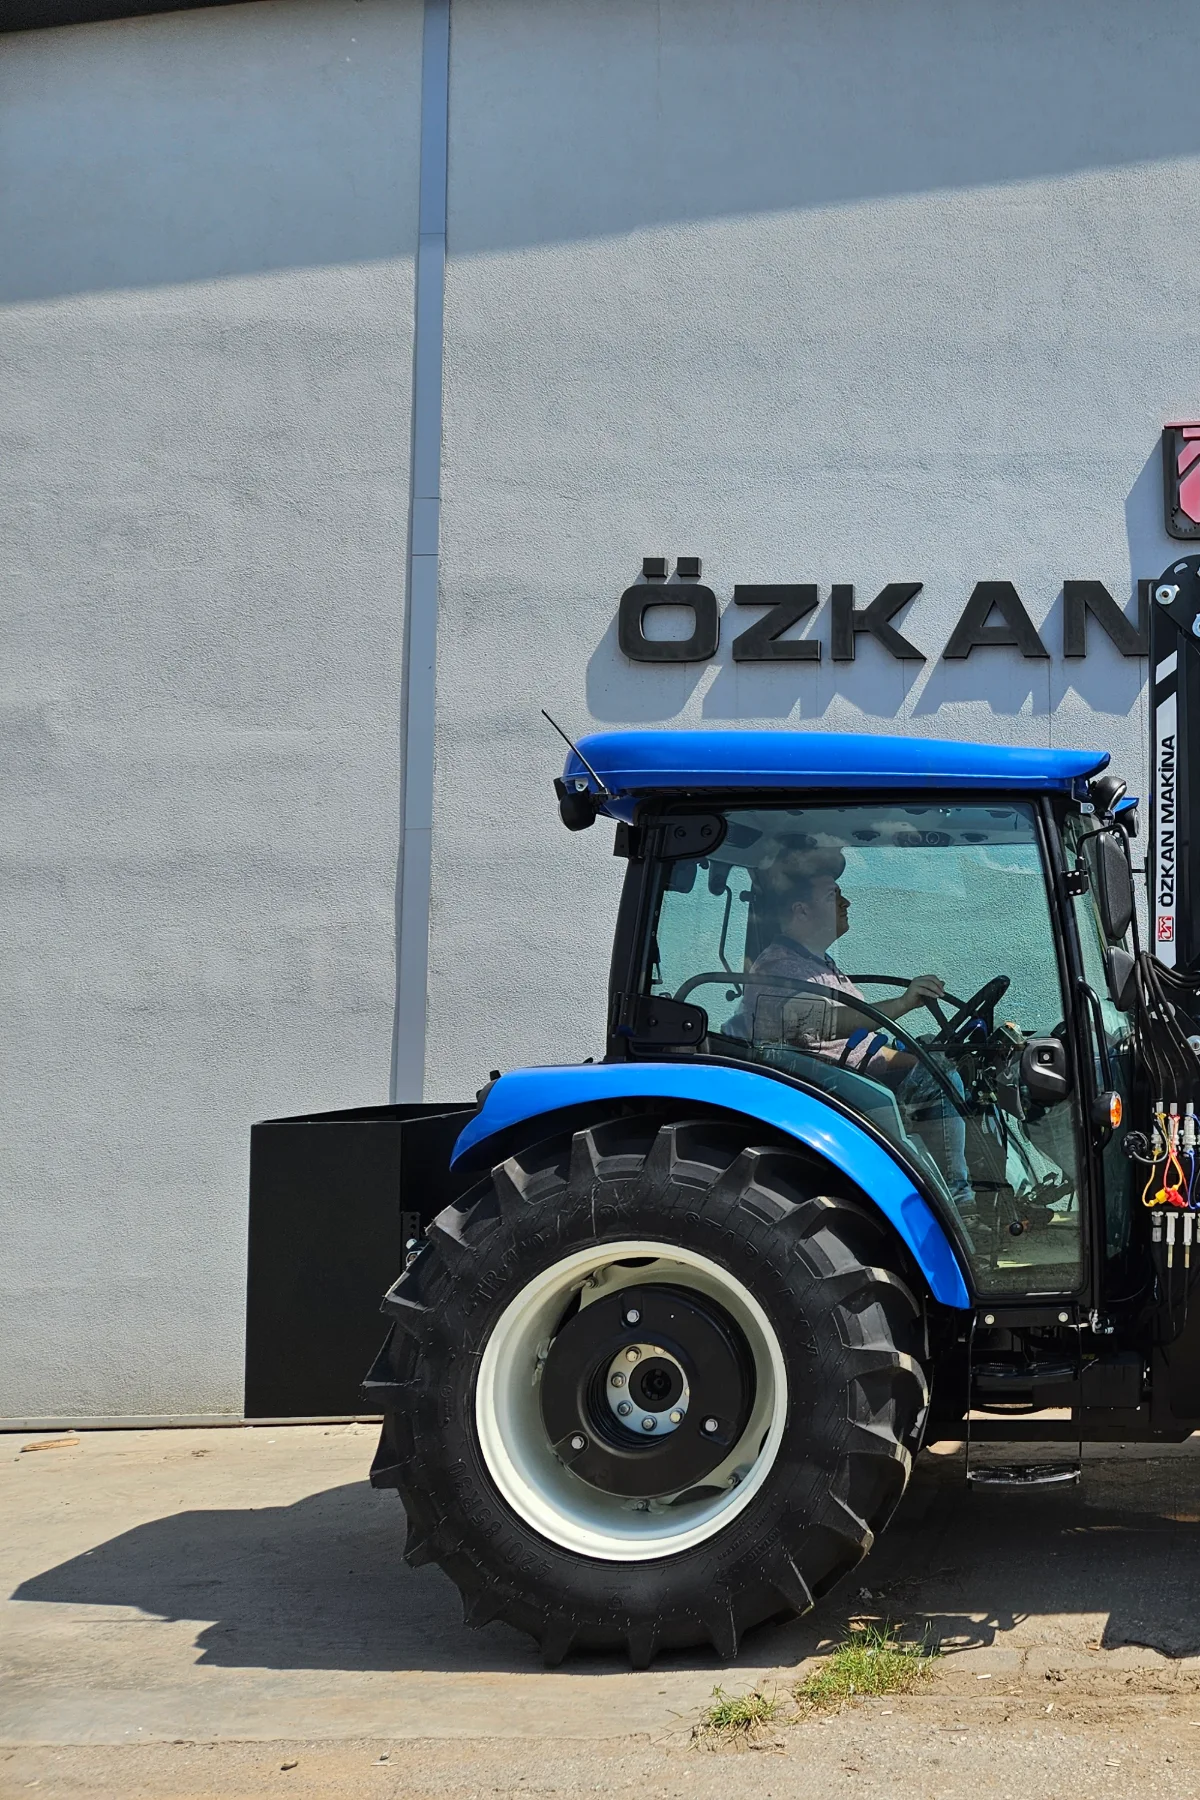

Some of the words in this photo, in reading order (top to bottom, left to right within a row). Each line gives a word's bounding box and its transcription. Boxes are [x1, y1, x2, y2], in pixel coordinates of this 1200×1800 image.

[618, 557, 1150, 662] ÖZKAN
[1158, 735, 1175, 823] MAKİNA
[1158, 830, 1175, 907] ÖZKAN
